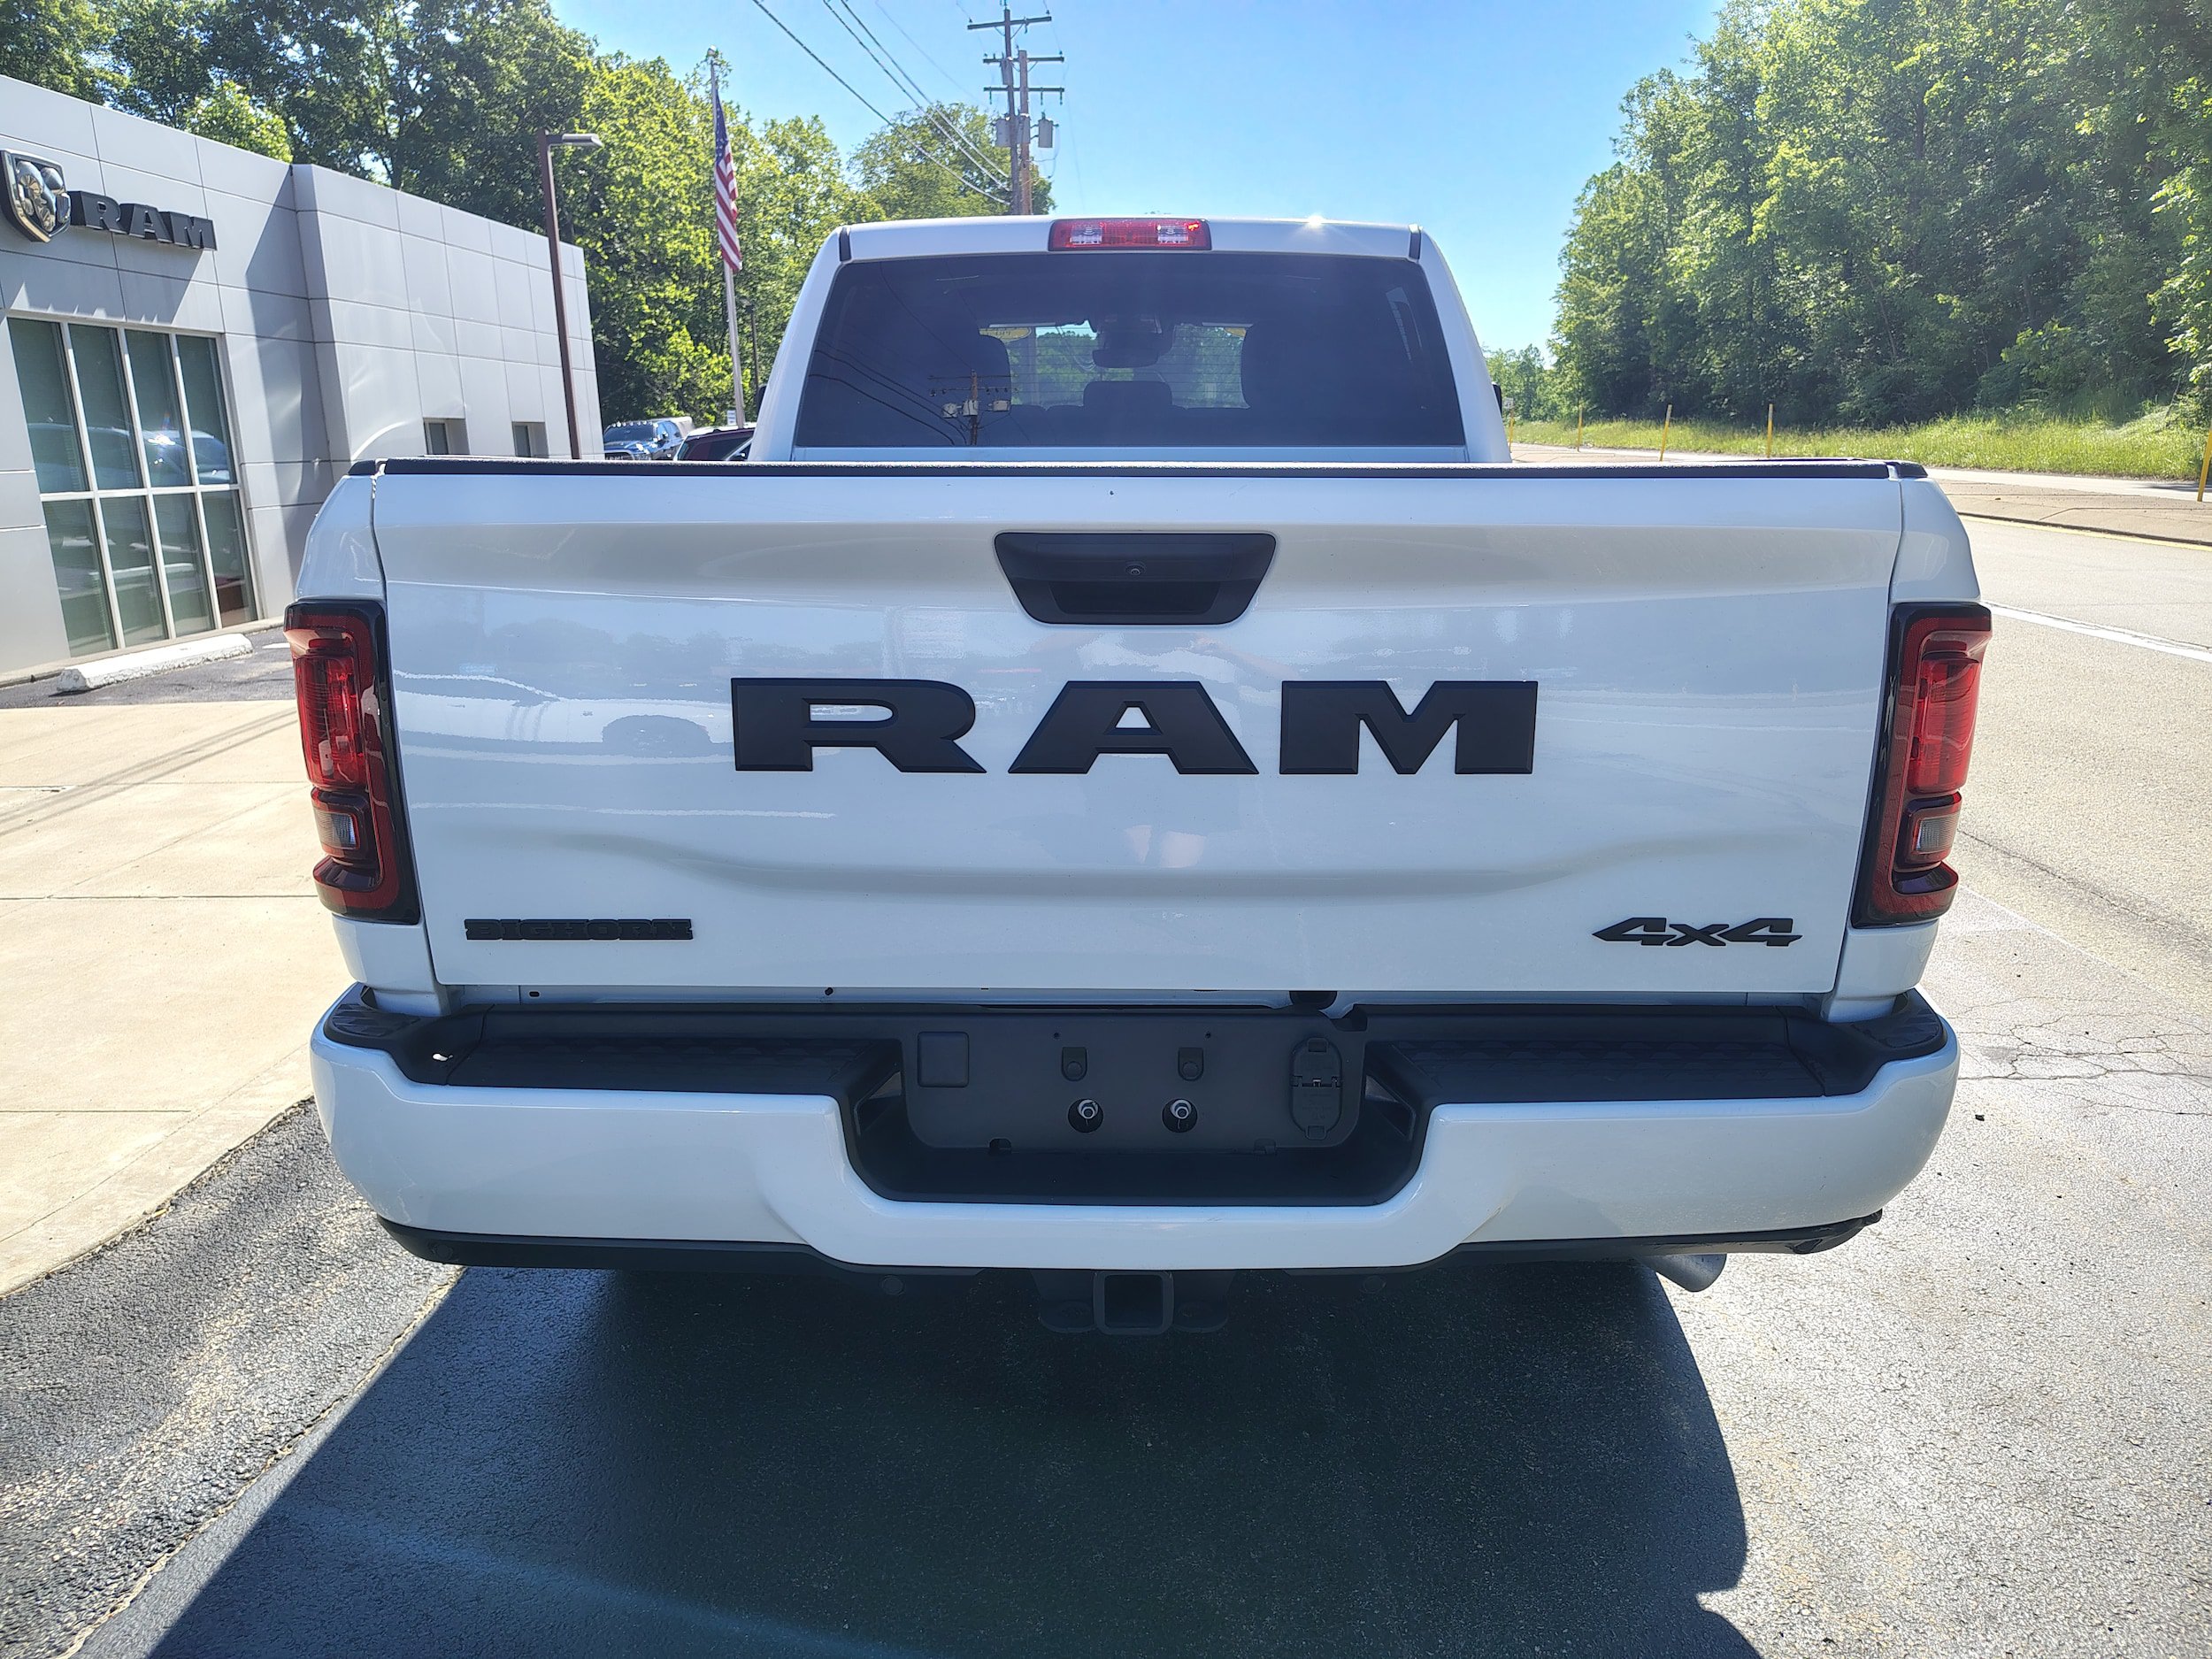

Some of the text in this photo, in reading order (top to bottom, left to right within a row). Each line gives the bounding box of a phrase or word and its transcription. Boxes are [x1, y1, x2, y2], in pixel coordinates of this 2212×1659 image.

[70, 190, 218, 250] RAM
[731, 678, 1538, 775] RAM
[1592, 917, 1803, 947] 4x4
